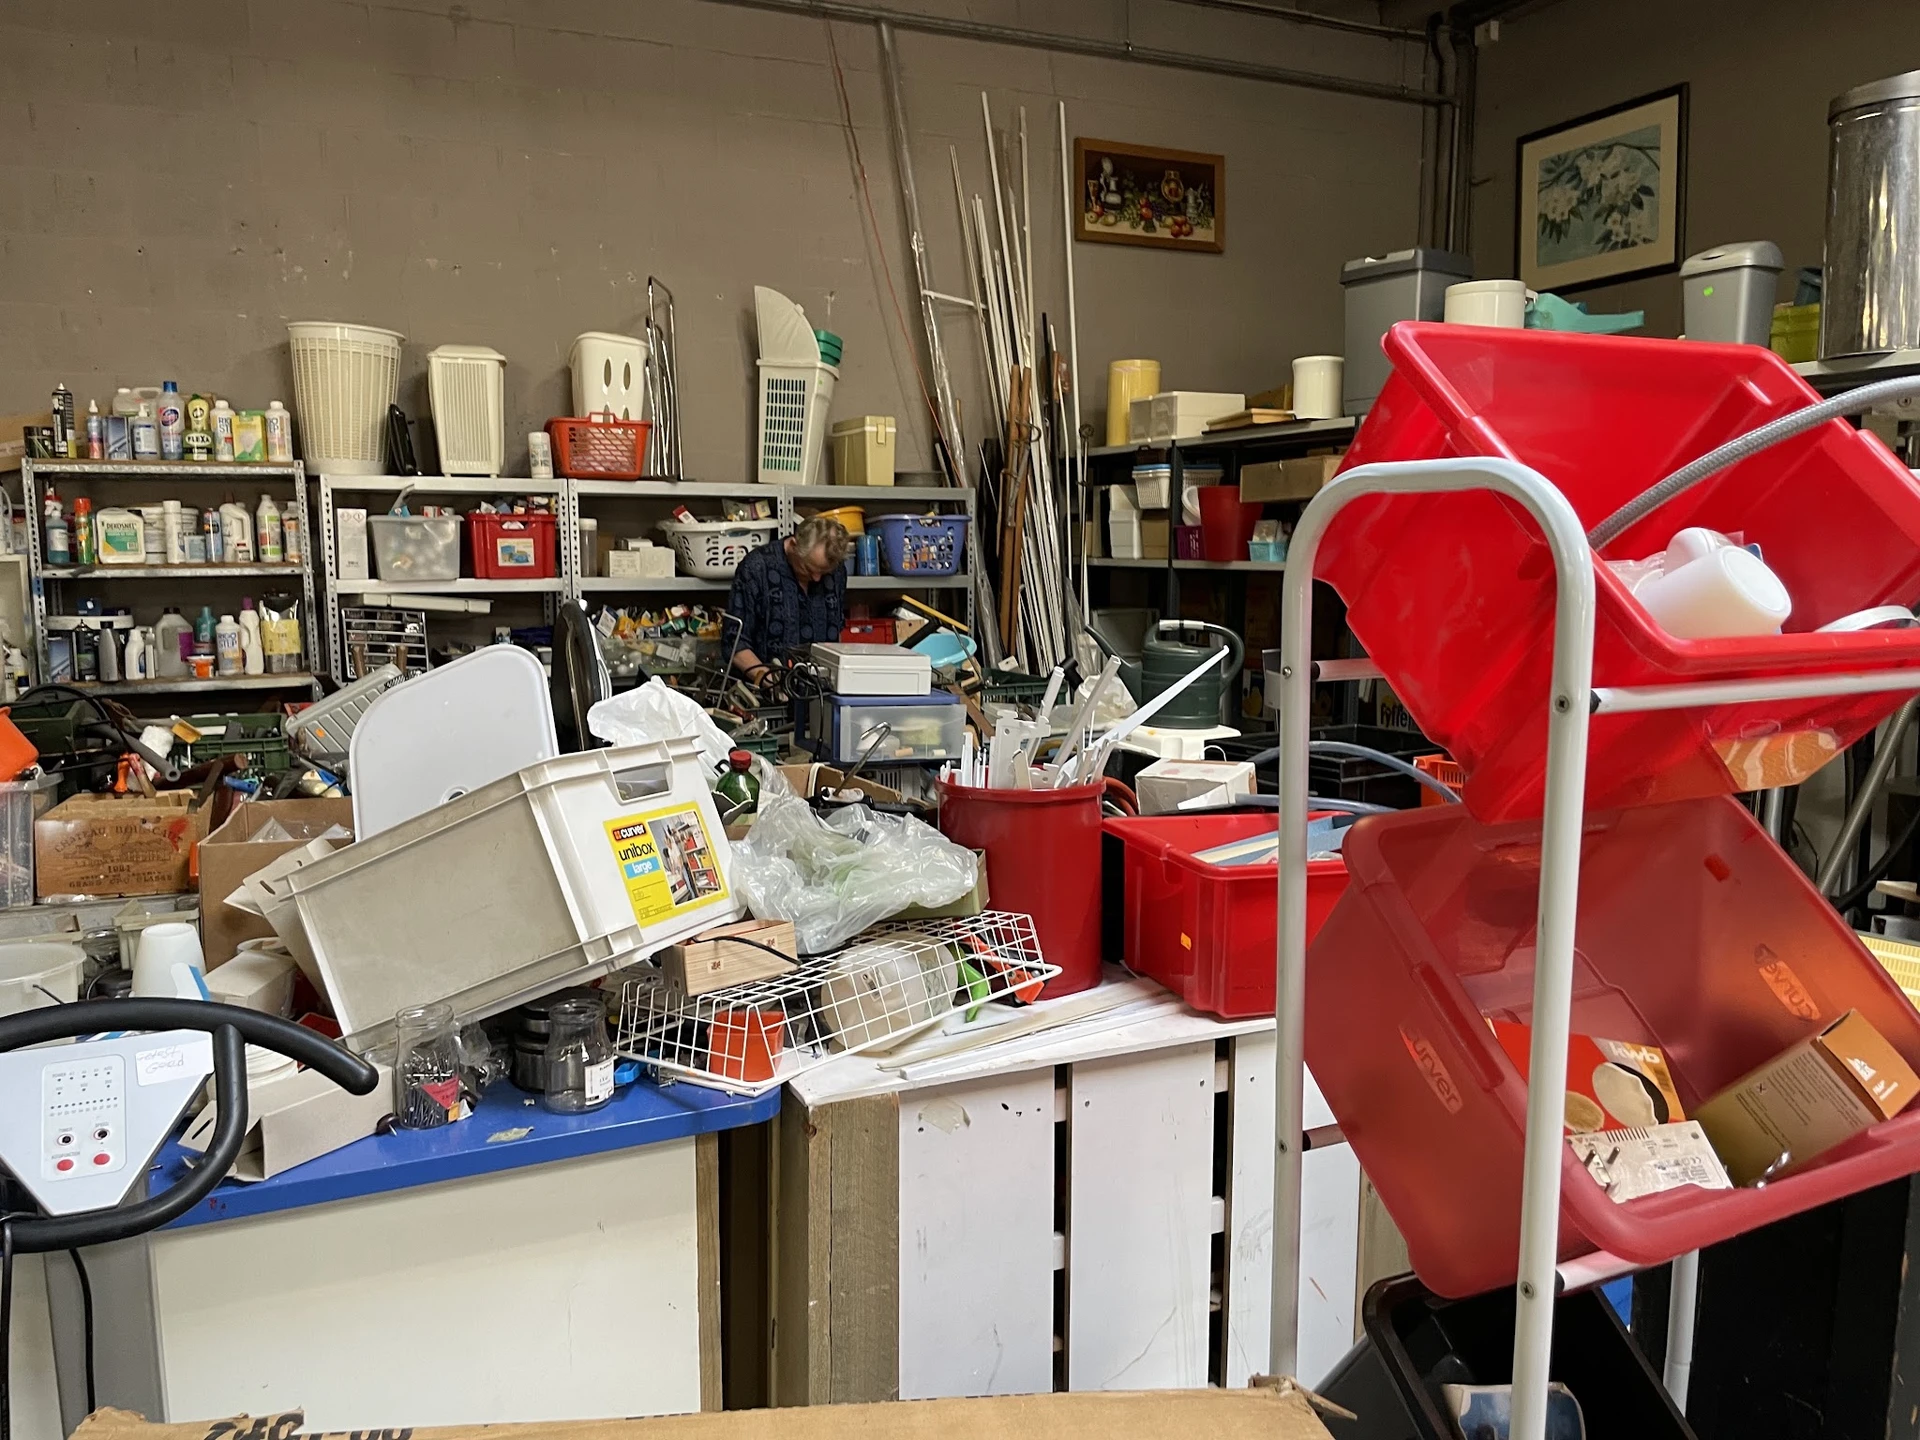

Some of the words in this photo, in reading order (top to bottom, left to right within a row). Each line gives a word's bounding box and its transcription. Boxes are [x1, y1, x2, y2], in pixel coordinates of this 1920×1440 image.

[1380, 702, 1409, 728] fyffe
[620, 824, 645, 839] curver
[618, 842, 655, 861] unibox
[631, 860, 653, 874] large
[69, 879, 102, 888] GRAND
[1406, 1031, 1460, 1104] urver
